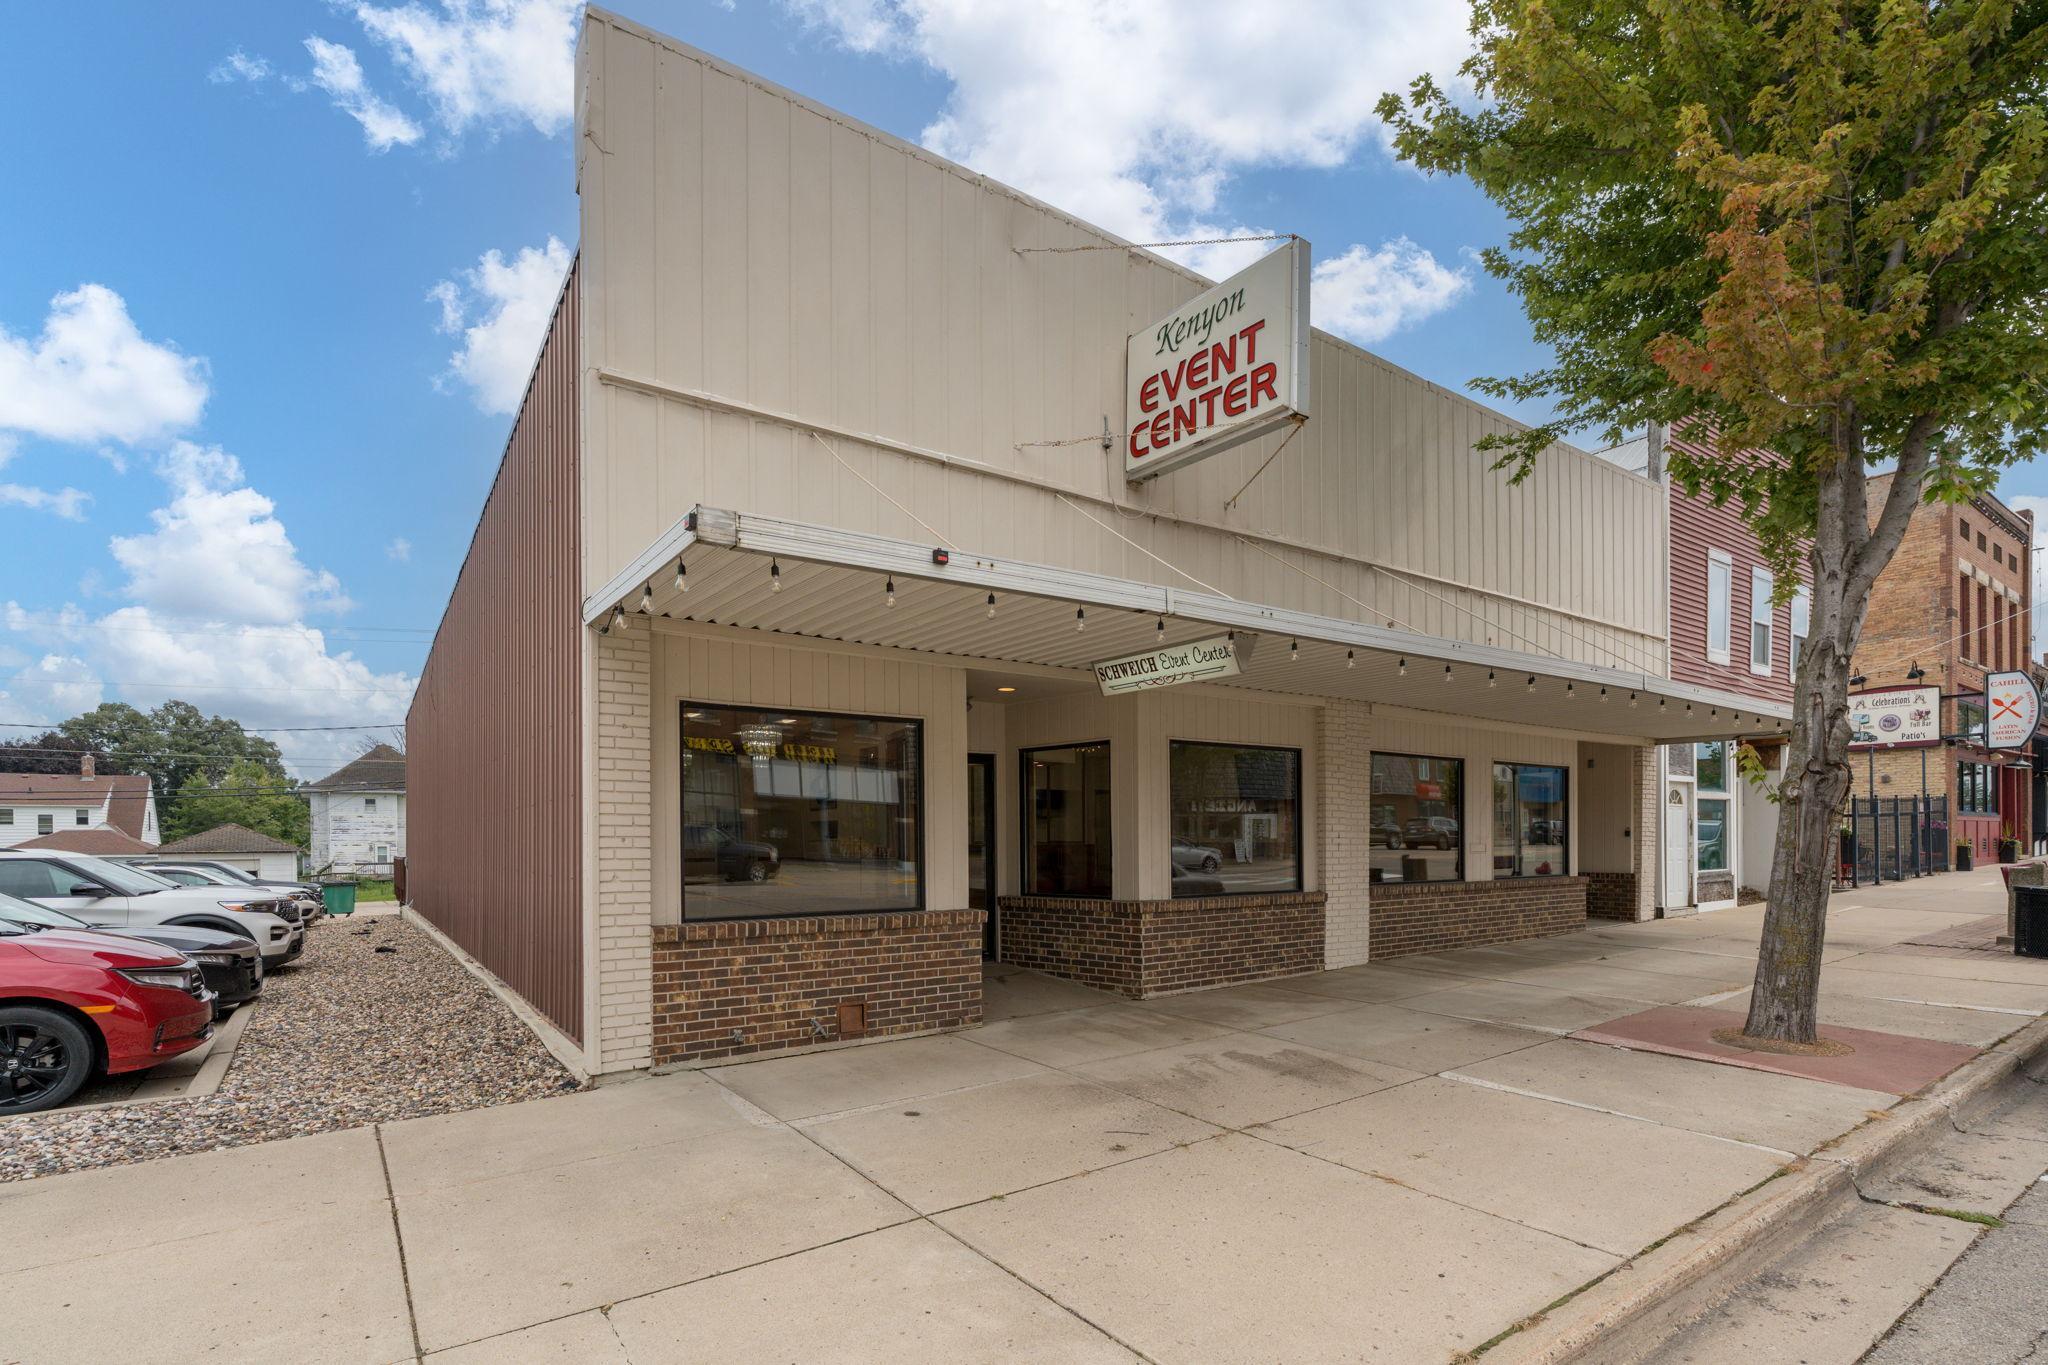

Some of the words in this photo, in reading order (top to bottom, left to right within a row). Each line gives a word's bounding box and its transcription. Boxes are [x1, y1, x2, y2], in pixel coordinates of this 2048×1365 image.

[1155, 287, 1245, 355] Kenyon
[1139, 319, 1266, 414] EVENT
[1130, 362, 1278, 458] CENTER
[1098, 656, 1159, 682] SCHWEICH
[1159, 652, 1191, 670] Event
[1192, 645, 1232, 664] Center
[1872, 696, 1911, 707] Celebrations
[1990, 678, 2027, 688] CAHILL
[1901, 732, 1926, 740] Patio's
